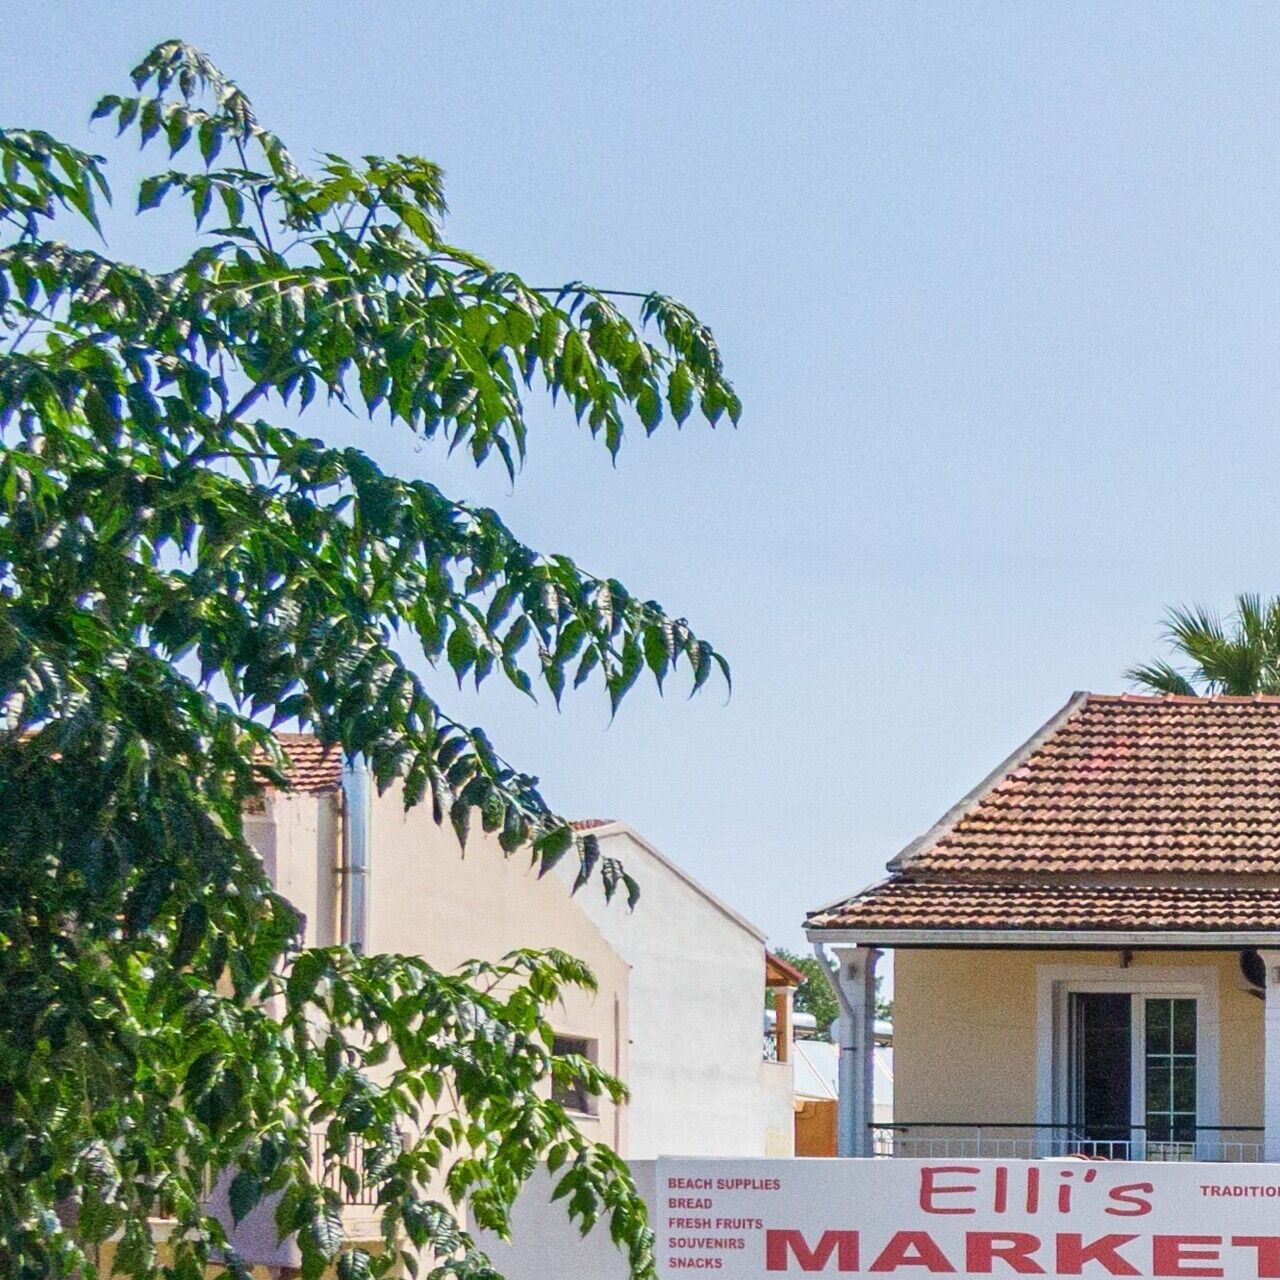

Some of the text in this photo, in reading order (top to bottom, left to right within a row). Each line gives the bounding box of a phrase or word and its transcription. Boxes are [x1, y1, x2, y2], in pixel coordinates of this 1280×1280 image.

[668, 1178, 780, 1191] BEACH SUPPLIES
[919, 1165, 1153, 1217] Elli's
[668, 1198, 713, 1209] BREAD
[668, 1218, 763, 1230] FRESH FRUITS
[669, 1238, 745, 1249] SOUVENIRS
[668, 1258, 722, 1269] SNACKS
